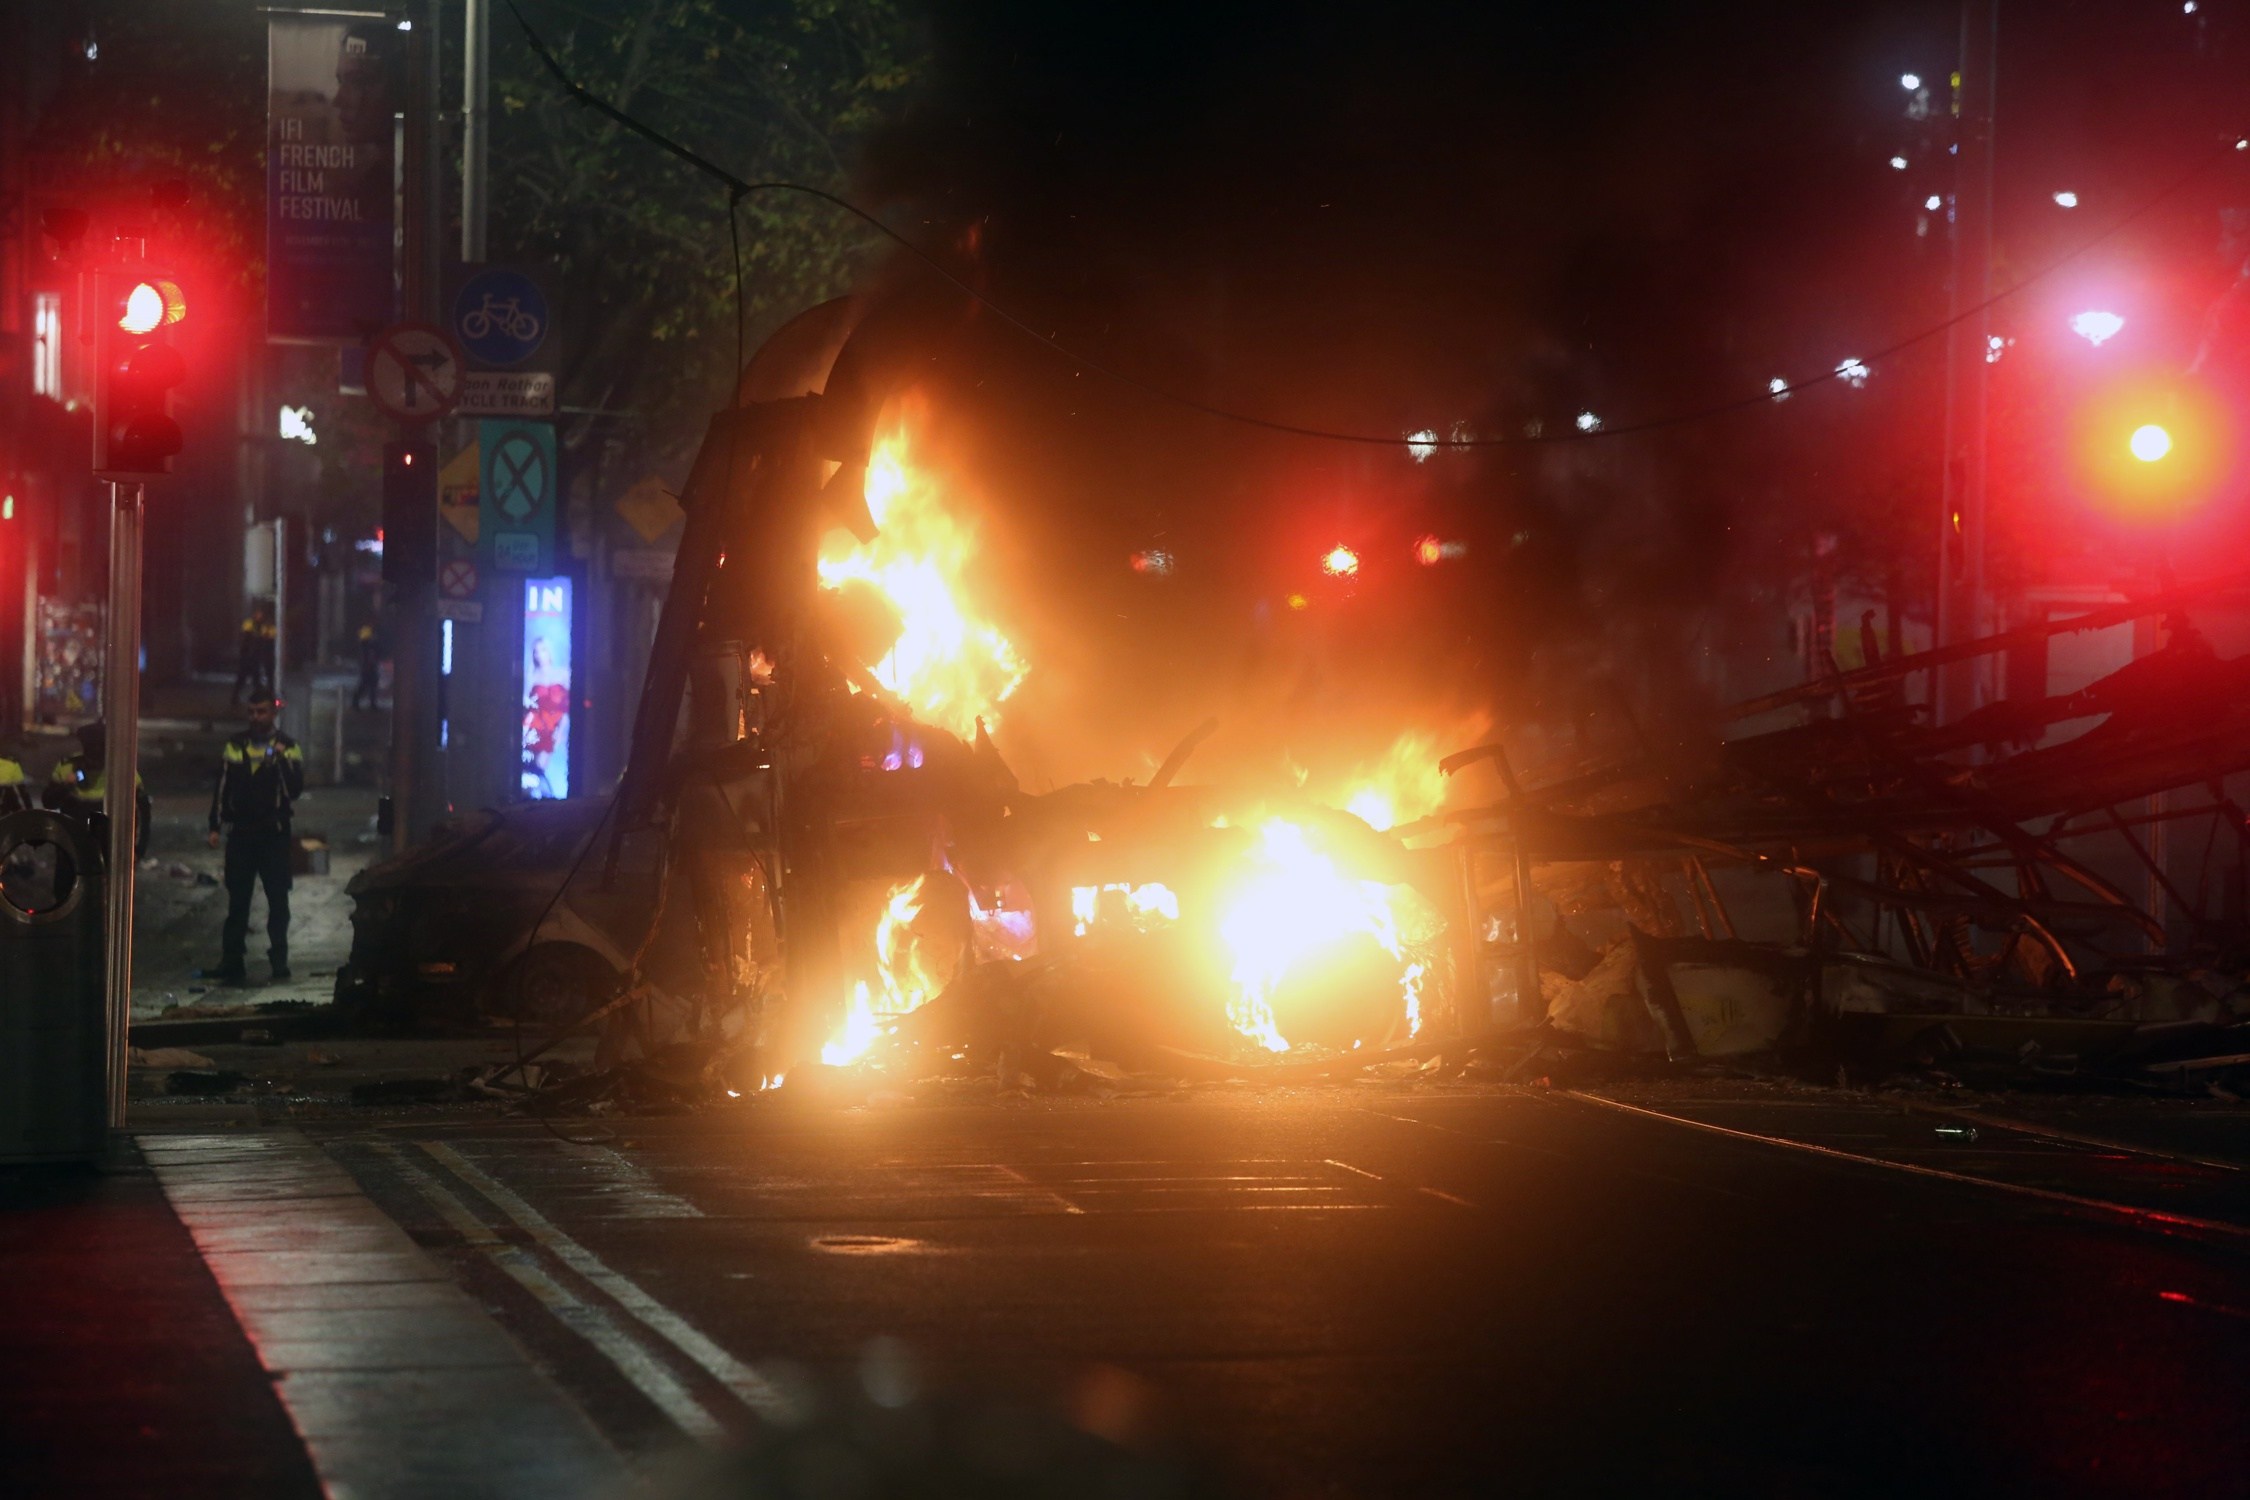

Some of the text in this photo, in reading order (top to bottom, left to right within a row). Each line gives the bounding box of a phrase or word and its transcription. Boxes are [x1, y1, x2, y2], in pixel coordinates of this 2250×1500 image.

[280, 118, 302, 140] IFI
[281, 144, 354, 168] FRENCH
[280, 170, 324, 193] FILM
[280, 197, 363, 220] FESTIVAL
[501, 395, 549, 408] TRACK
[529, 586, 563, 612] IN
